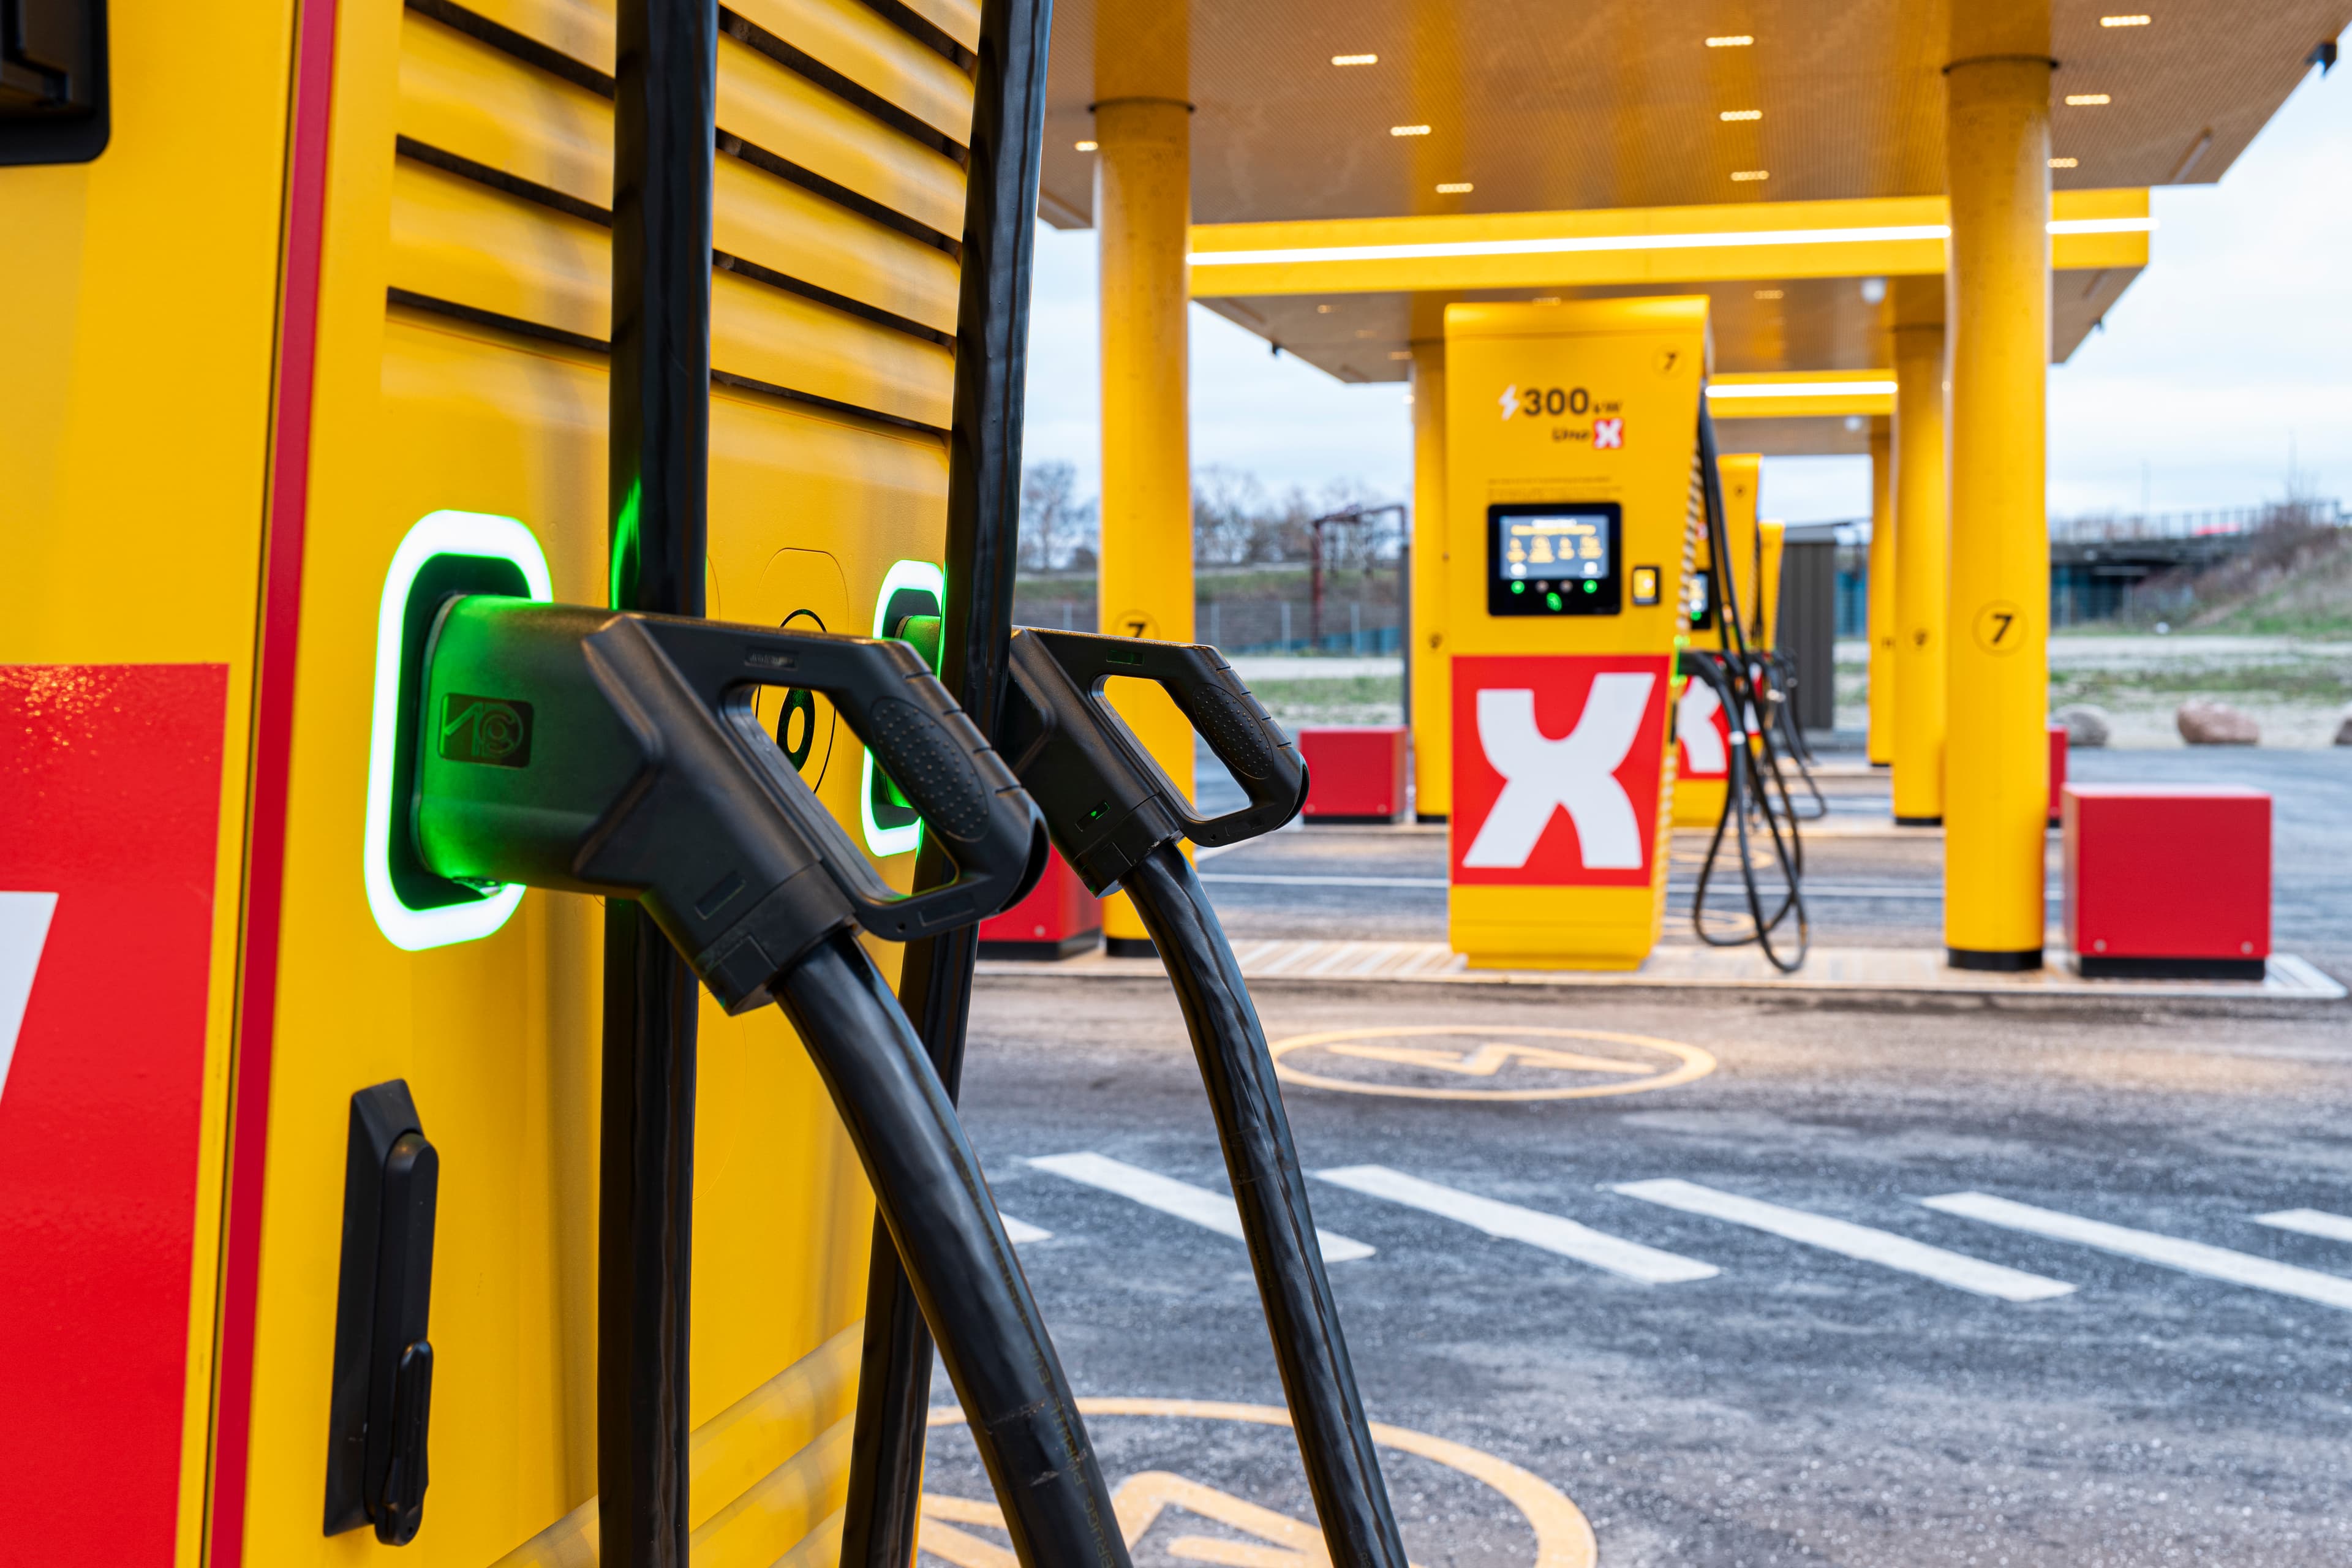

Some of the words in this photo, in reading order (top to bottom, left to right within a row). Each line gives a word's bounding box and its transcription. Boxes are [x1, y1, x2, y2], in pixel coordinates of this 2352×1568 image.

[1664, 352, 1678, 372] 7
[1523, 388, 1590, 417] 300
[1127, 621, 1146, 638] 7
[1991, 613, 2013, 646] 7
[1461, 672, 1656, 869] X
